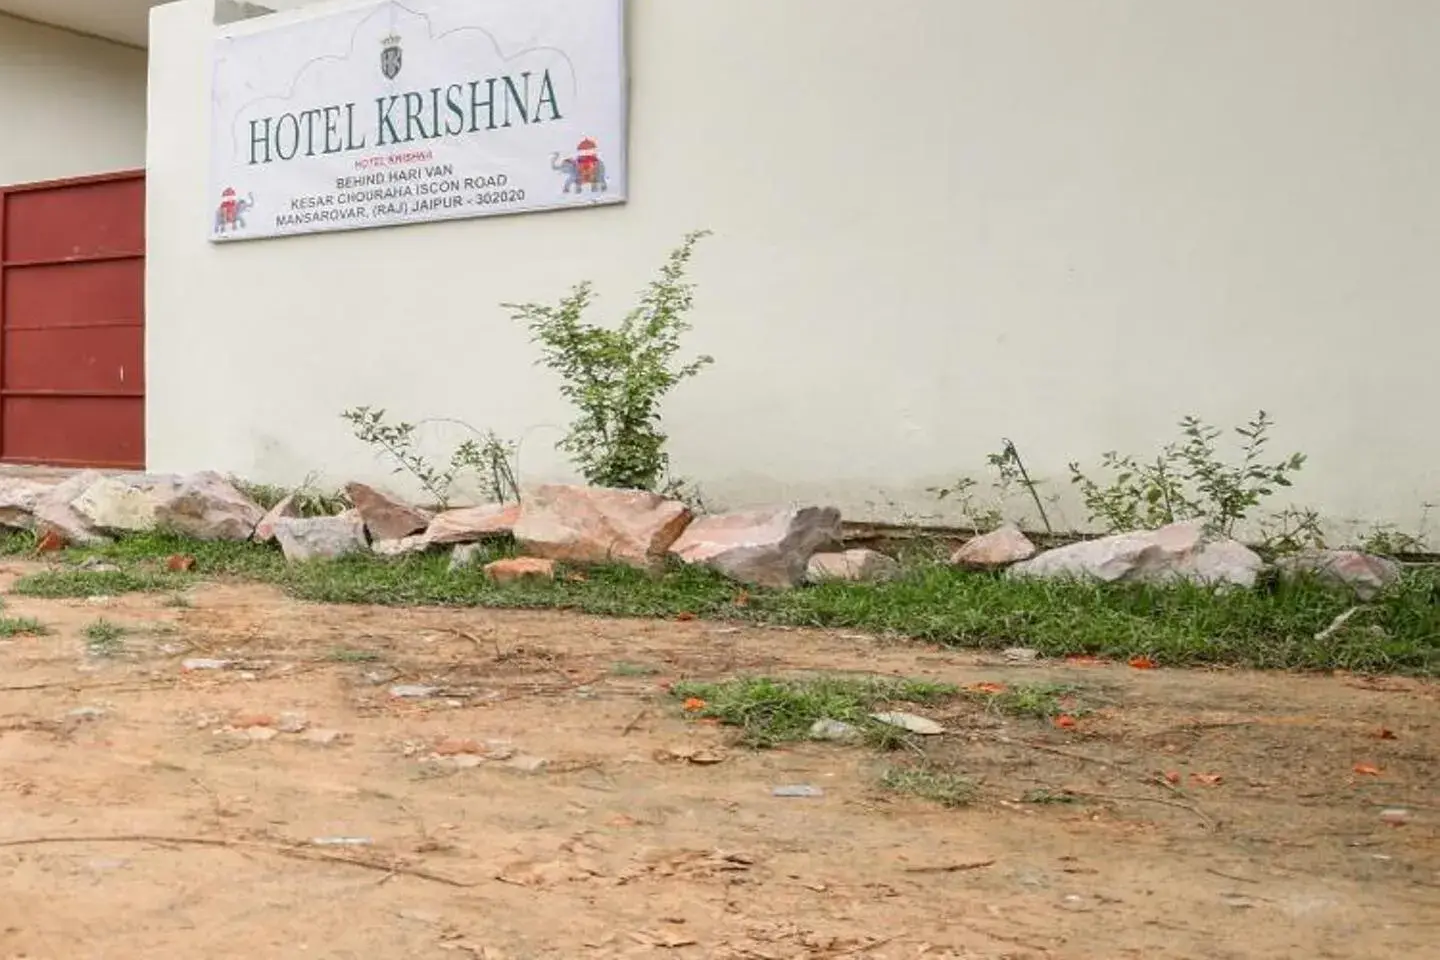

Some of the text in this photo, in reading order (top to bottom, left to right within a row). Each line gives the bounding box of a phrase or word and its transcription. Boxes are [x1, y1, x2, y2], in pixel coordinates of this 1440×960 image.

[248, 68, 563, 165] HOTEL KRISHNA
[335, 163, 453, 189] BEHIND HARI VAN
[354, 155, 387, 169] HOTEL
[276, 206, 369, 227] MANSAROVAR,
[372, 201, 408, 218] (RAJ)
[412, 195, 463, 213] JAIPUR
[475, 189, 525, 206] 302020
[291, 174, 508, 210] KESAR CHOURAHA ISCON ROAD
